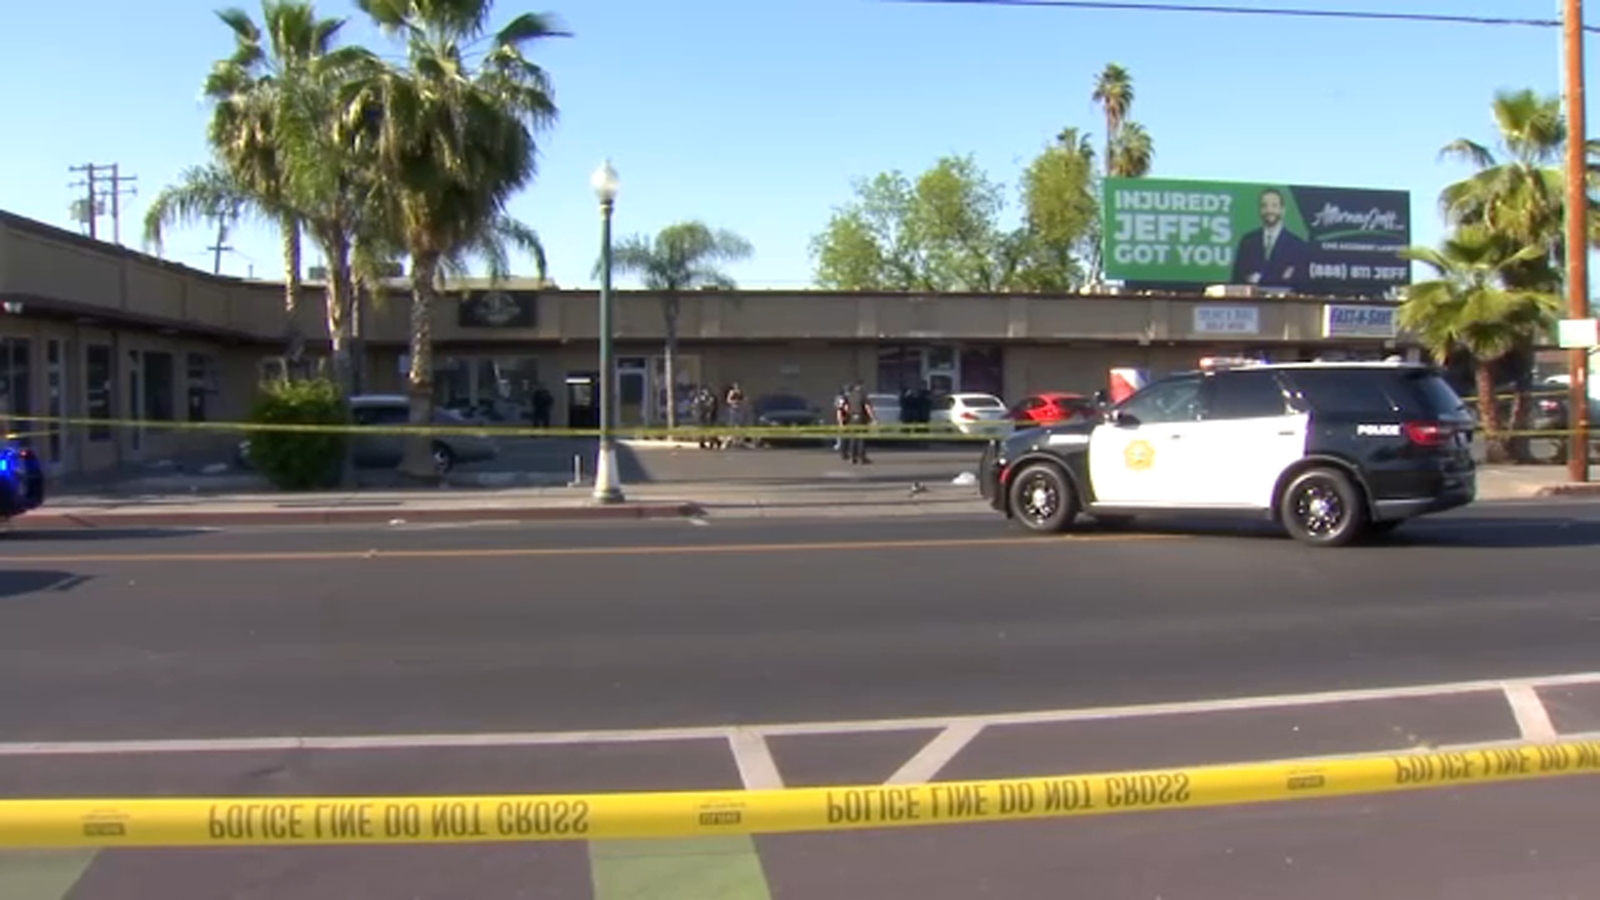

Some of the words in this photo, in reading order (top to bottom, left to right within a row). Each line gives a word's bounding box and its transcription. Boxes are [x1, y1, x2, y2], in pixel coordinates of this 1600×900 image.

[1115, 190, 1232, 213] INJURED?
[1114, 213, 1232, 243] JEFF'S
[1115, 243, 1170, 264] GOT
[1176, 245, 1232, 265] YOU
[1357, 424, 1400, 436] POLICE
